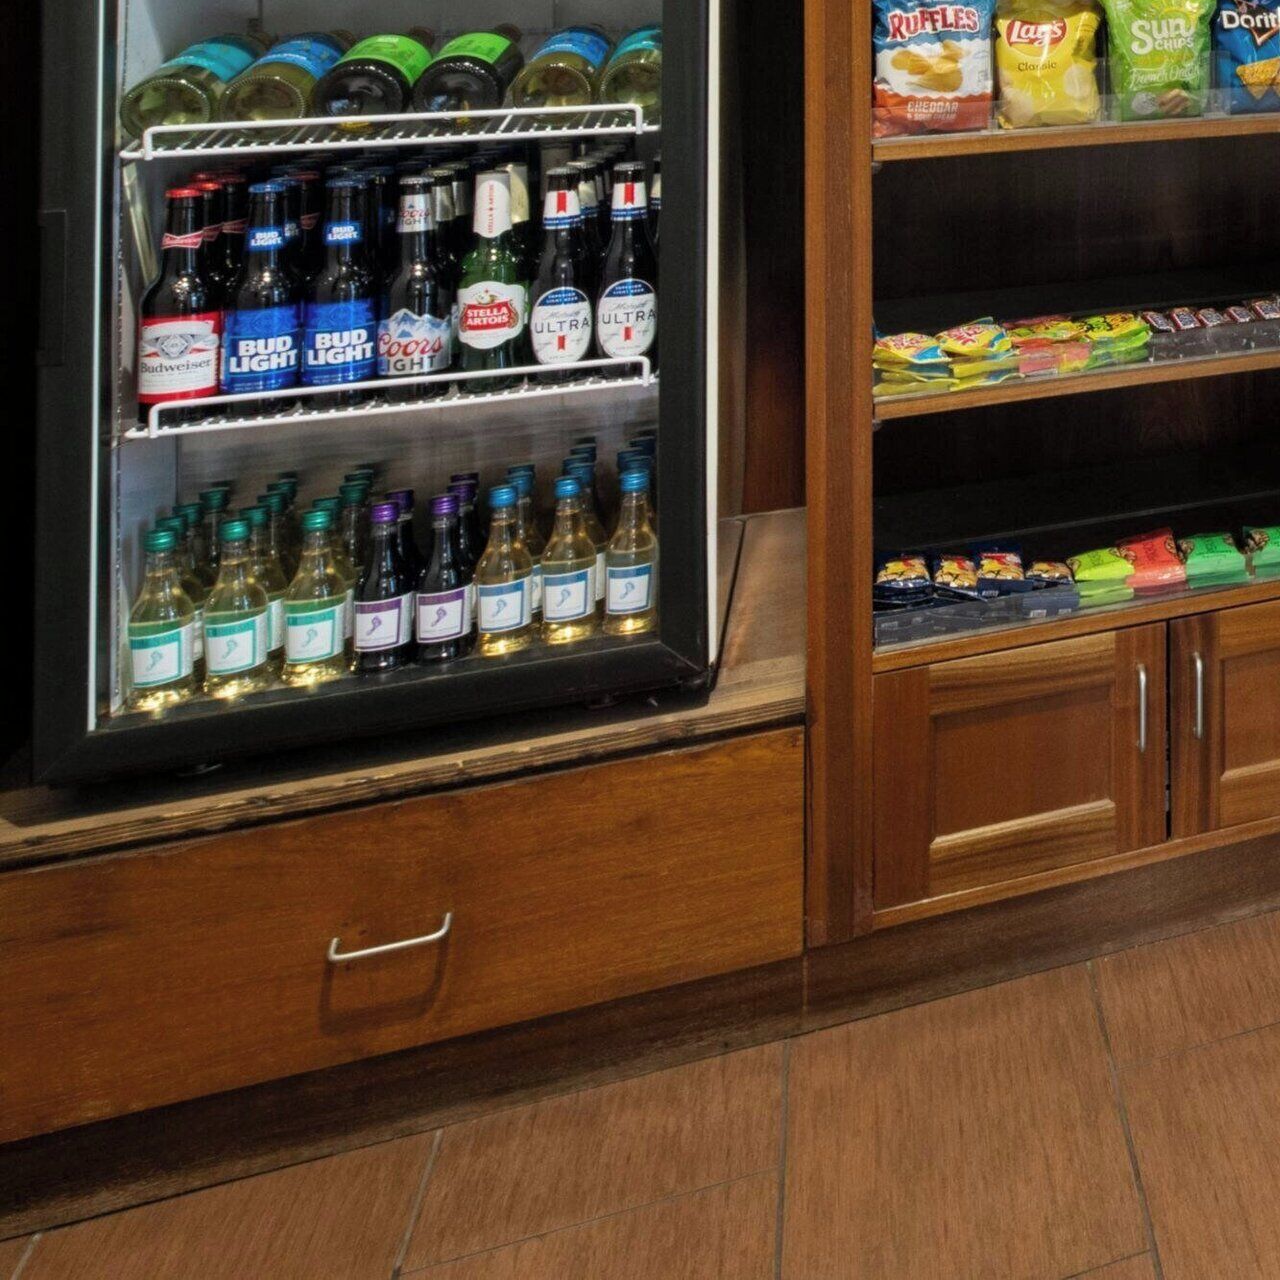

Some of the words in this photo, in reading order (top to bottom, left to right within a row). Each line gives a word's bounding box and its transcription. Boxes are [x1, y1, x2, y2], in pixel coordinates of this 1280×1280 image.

[888, 5, 979, 41] RUFFLES
[1010, 20, 1064, 47] Lay's
[1131, 17, 1195, 55] Sun
[1154, 36, 1194, 52] CHIPS
[1018, 62, 1057, 72] Classic
[907, 101, 959, 111] CHEDDAR
[255, 231, 279, 239] BUD
[327, 231, 359, 241] LIGHT
[332, 225, 354, 234] BUD
[251, 236, 282, 247] LIGHT
[467, 307, 509, 317] STELLA
[601, 309, 657, 325] ULTRA
[466, 316, 509, 326] ARTOIS
[534, 317, 590, 334] ULTRA
[238, 336, 292, 356] BUD
[315, 329, 368, 349] BUD
[377, 333, 444, 357] Coors
[229, 349, 297, 373] LIGHT
[307, 342, 374, 365] LIGHT
[141, 358, 212, 373] Budweiser
[387, 355, 437, 373] IGHT
